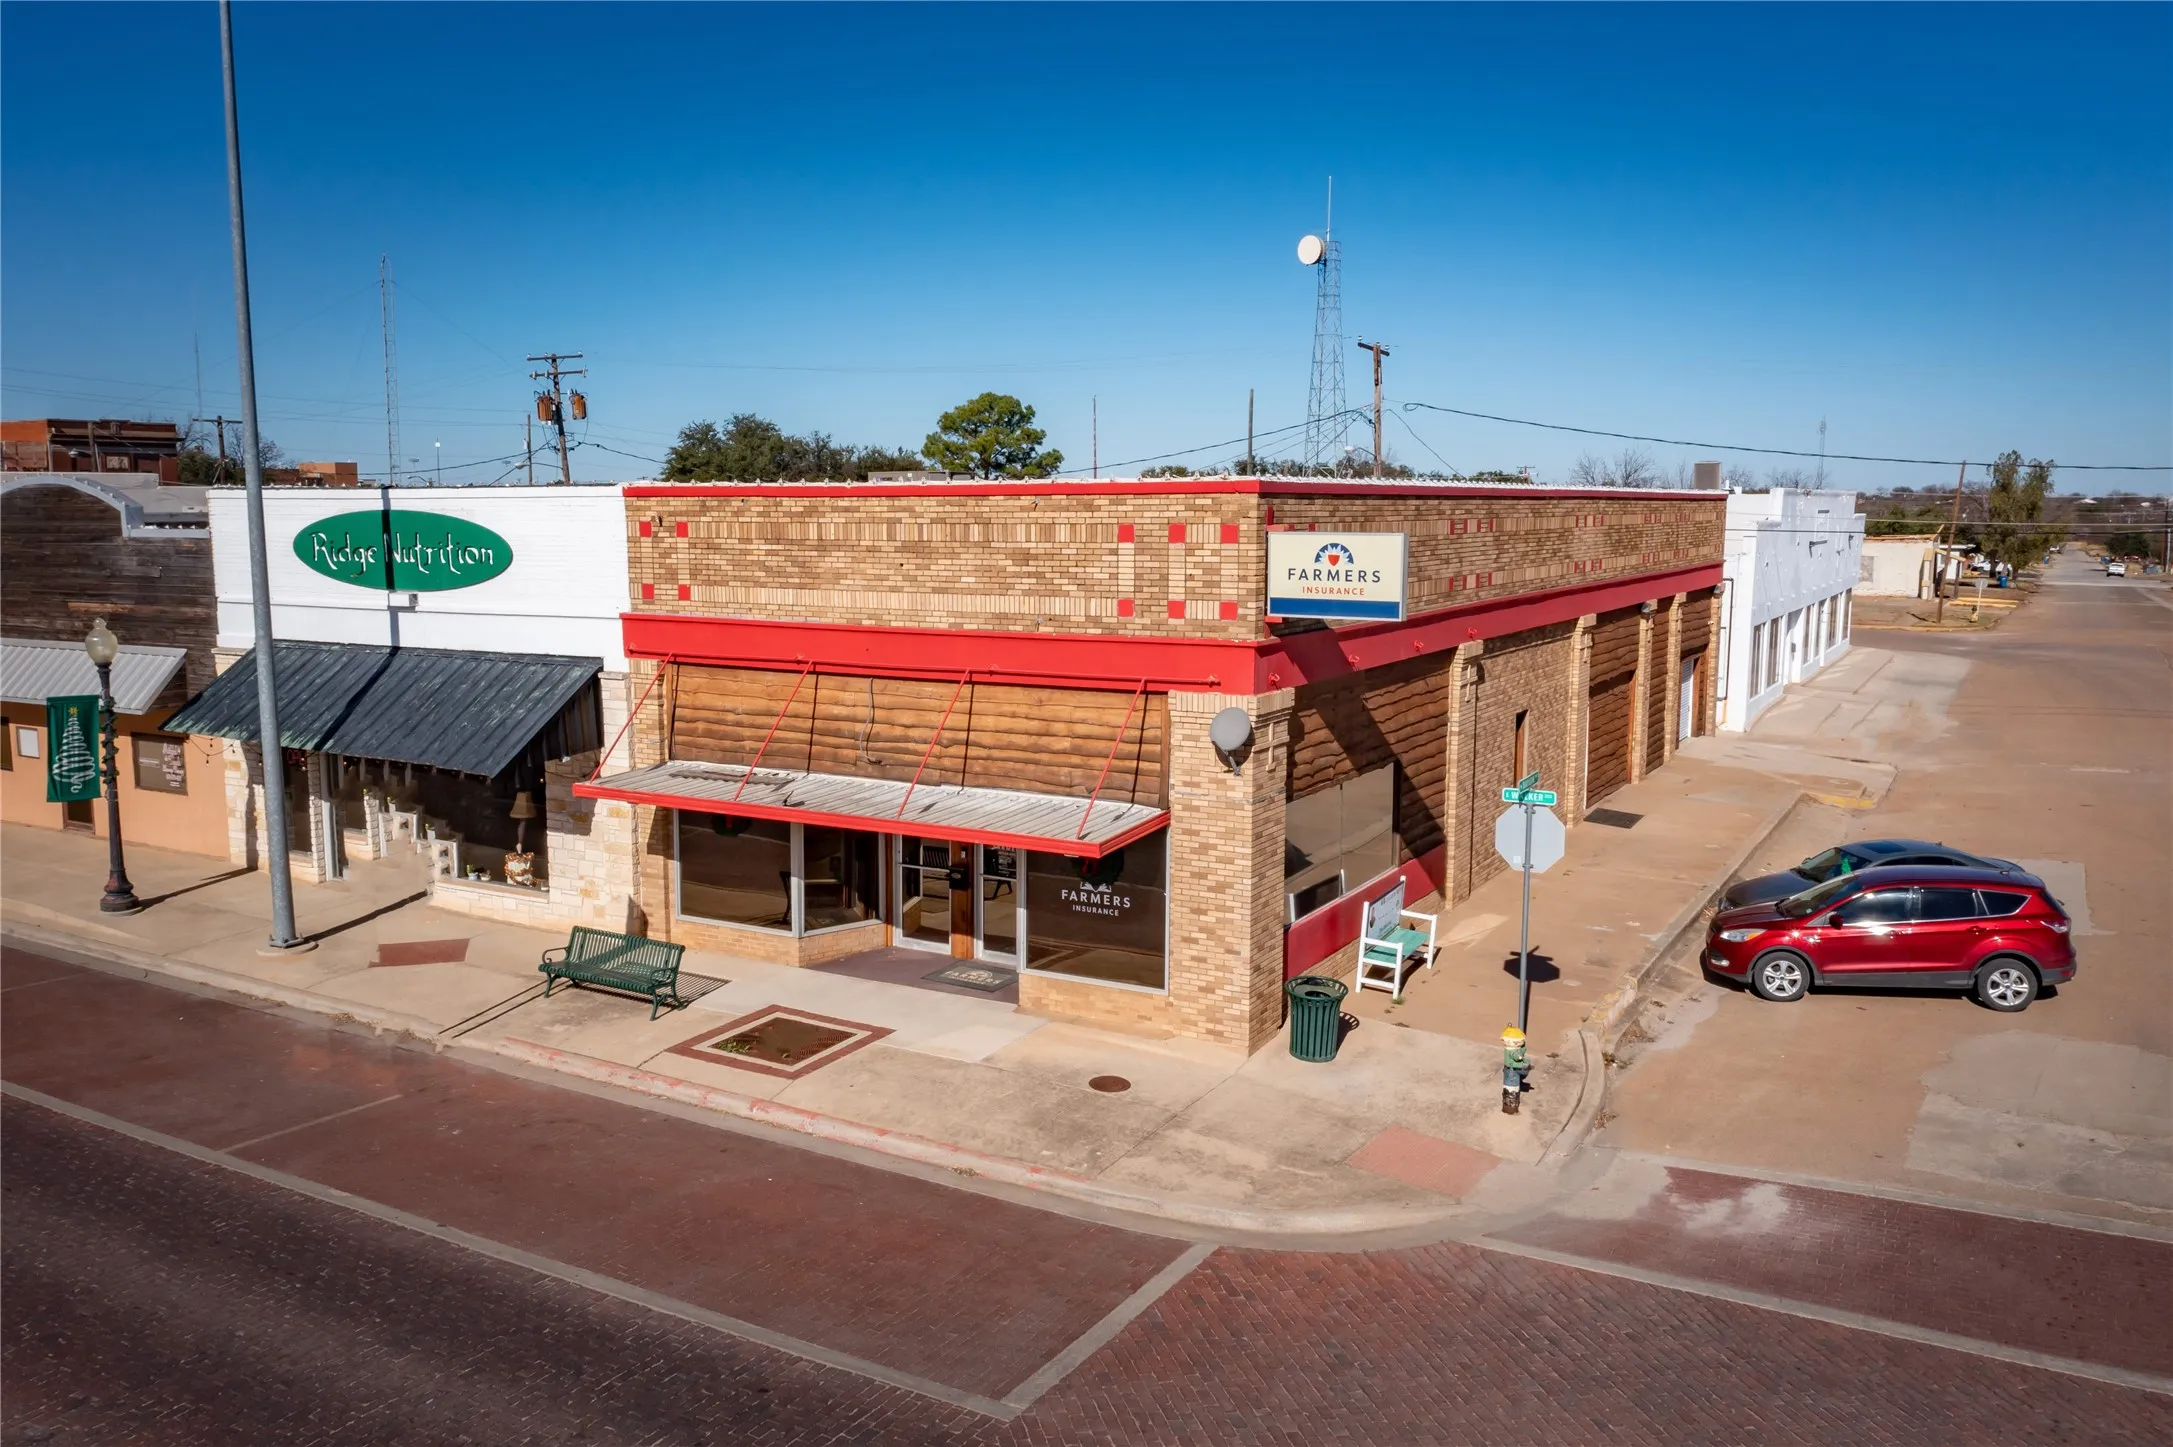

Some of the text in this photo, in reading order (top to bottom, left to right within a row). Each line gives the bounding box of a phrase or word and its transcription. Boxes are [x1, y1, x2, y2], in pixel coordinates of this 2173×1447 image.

[308, 531, 494, 578] Ridge Nutrition
[1288, 568, 1381, 583] FARMERS
[1302, 586, 1365, 596] INSURANCE
[1511, 790, 1544, 802] WLKER
[1061, 889, 1131, 908] FARMERS
[1072, 904, 1119, 917] INSURANCE
